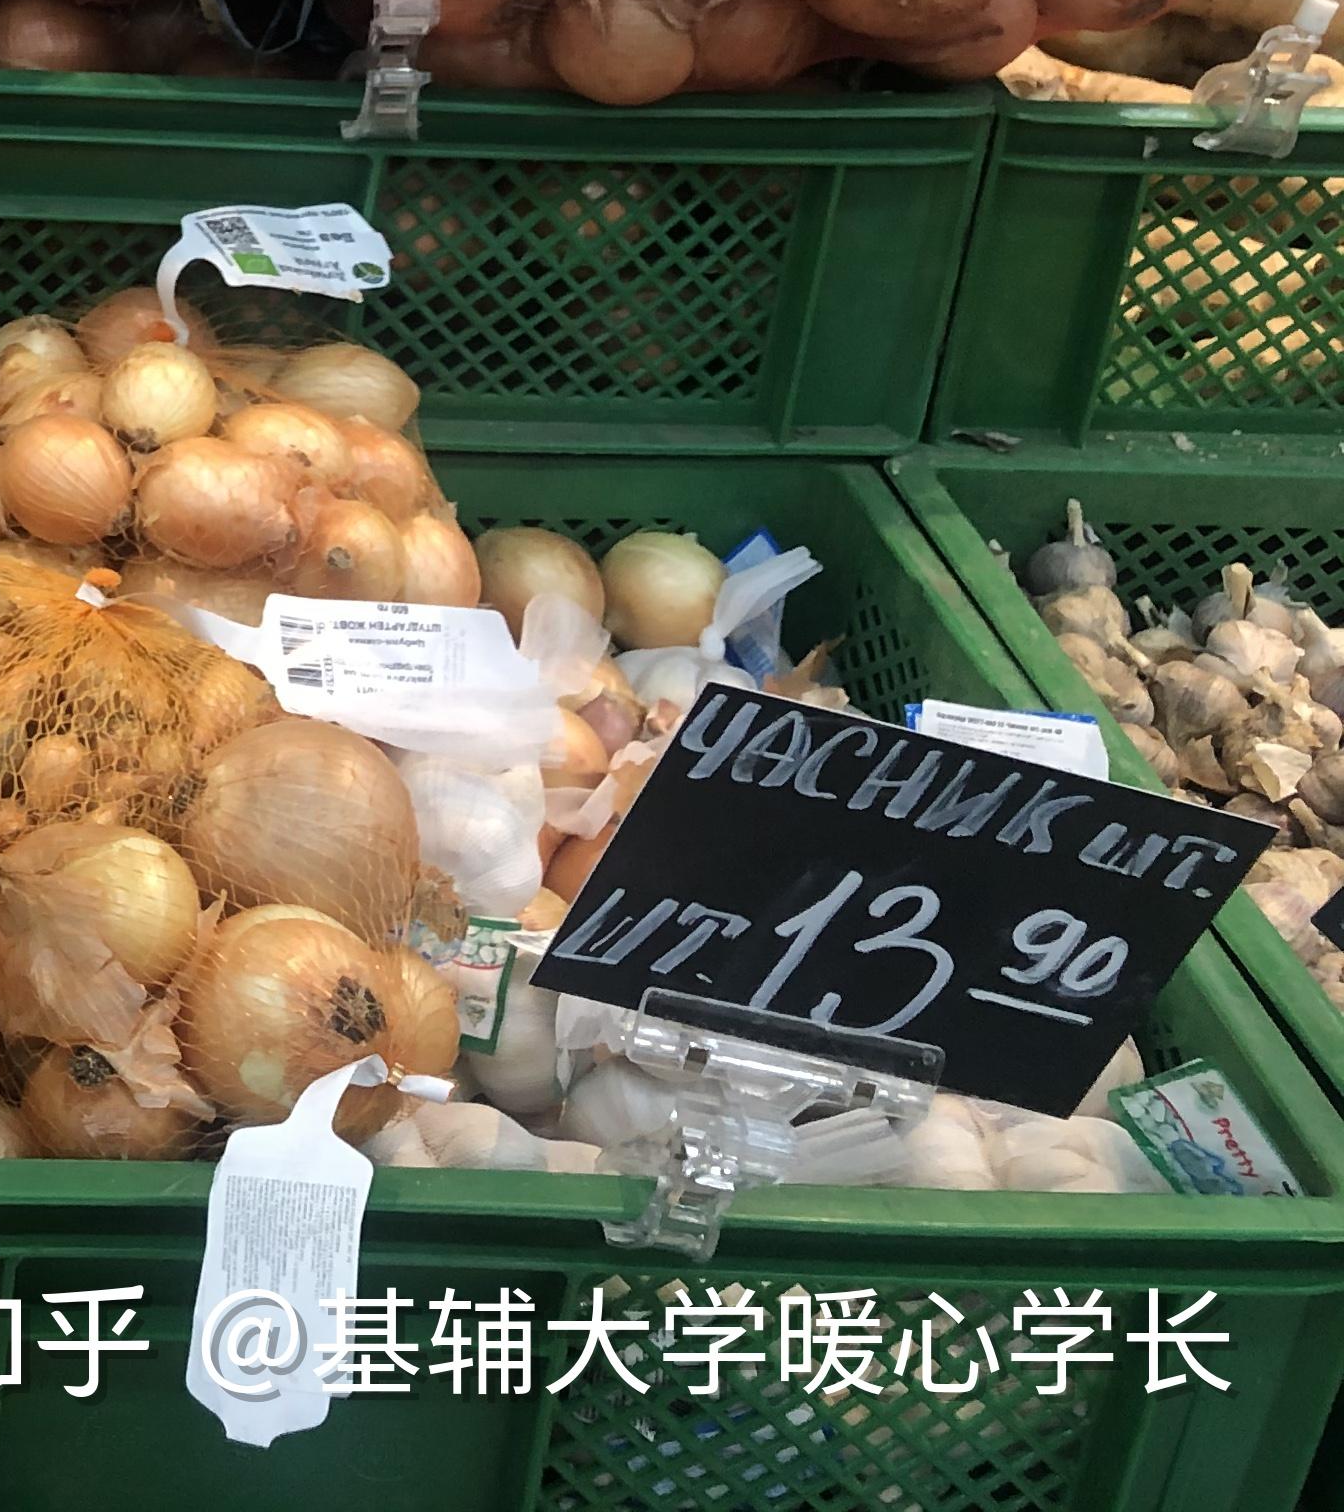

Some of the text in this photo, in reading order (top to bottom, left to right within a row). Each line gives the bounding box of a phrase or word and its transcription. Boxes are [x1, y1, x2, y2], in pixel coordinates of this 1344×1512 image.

[680, 693, 1095, 854] ЧАСНИК
[748, 870, 955, 1039] 13
[1000, 908, 1131, 996] 90
